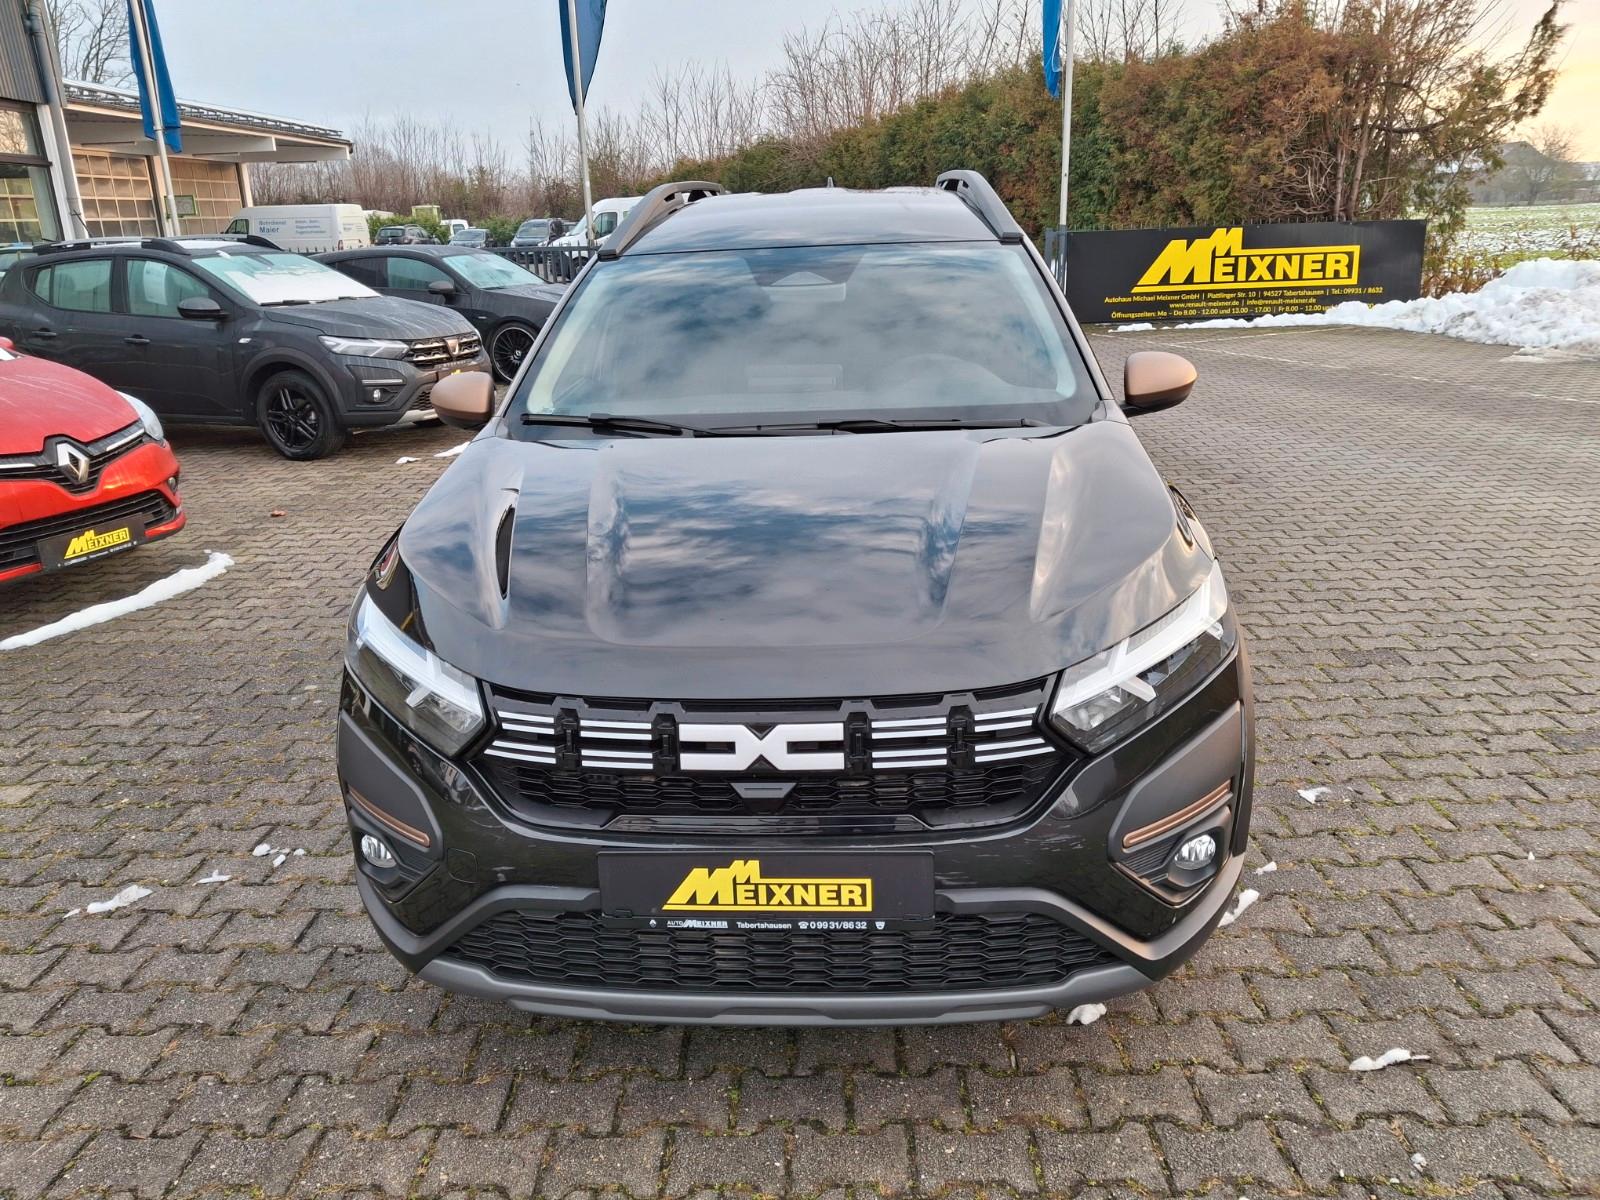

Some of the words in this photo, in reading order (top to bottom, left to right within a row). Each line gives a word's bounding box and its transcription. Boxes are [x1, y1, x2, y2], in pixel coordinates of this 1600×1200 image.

[1104, 296, 1132, 304] Autohaus
[1157, 294, 1180, 302] Meixner
[1169, 300, 1239, 309] www.renault-meixner.de
[1305, 304, 1321, 312] 12.00
[736, 921, 792, 930] Tabertshausen
